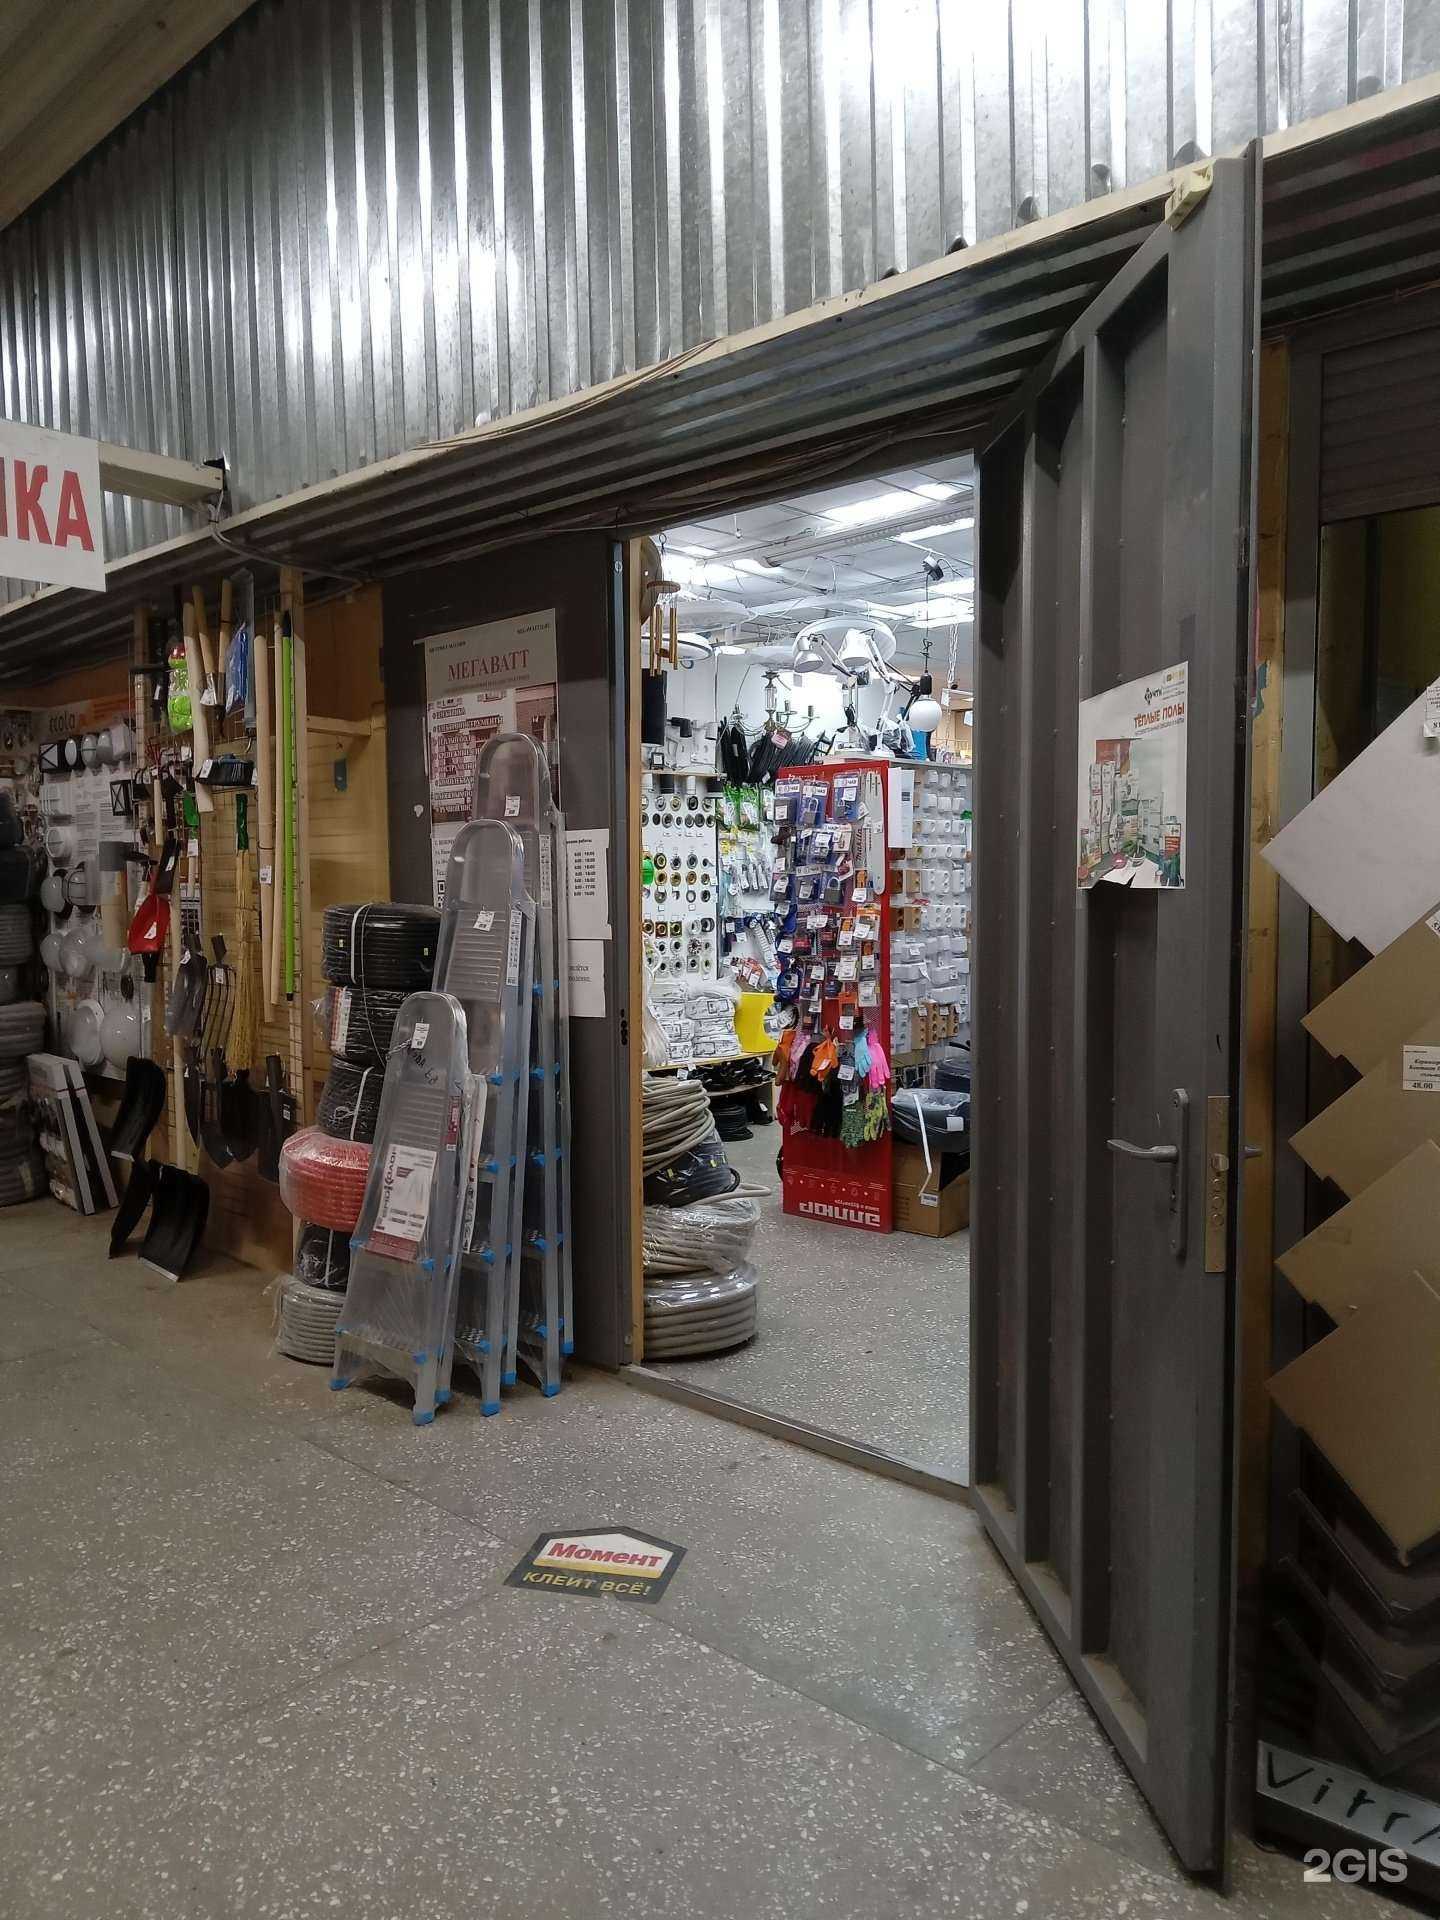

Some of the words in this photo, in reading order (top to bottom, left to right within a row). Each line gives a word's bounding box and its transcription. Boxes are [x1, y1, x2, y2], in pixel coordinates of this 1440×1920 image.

[0, 457, 95, 552] КА
[448, 649, 530, 682] МЕГАВАТТ
[1134, 709, 1160, 728] ТЁПЛЫЕ
[1162, 702, 1184, 720] ПОЛЫ
[547, 1542, 663, 1567] Момент
[522, 1571, 597, 1589] КЛЕИТ
[599, 1579, 652, 1596] ВСЁ!
